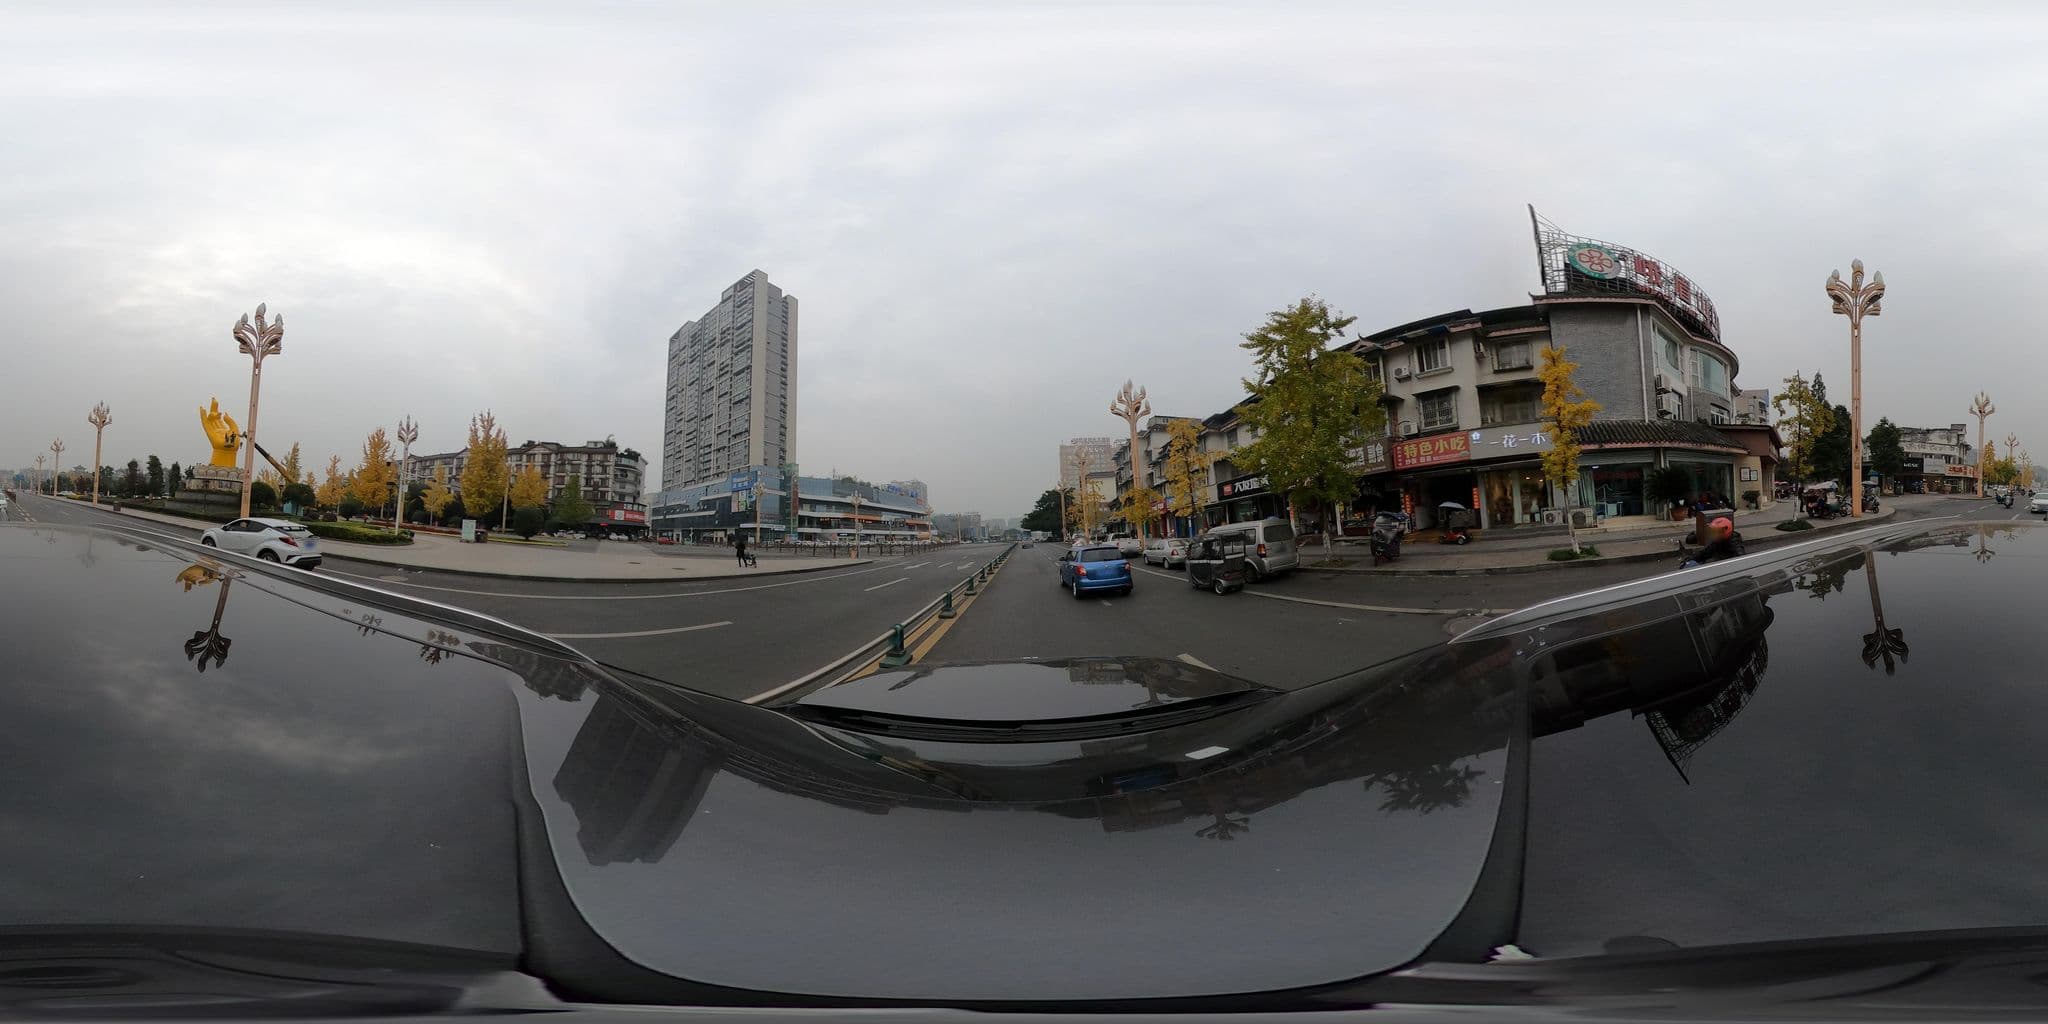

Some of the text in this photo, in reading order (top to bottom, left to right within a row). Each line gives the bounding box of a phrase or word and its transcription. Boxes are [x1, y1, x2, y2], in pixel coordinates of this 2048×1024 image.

[1403, 436, 1466, 459] 特色小吃
[1488, 432, 1547, 448] 一花一木
